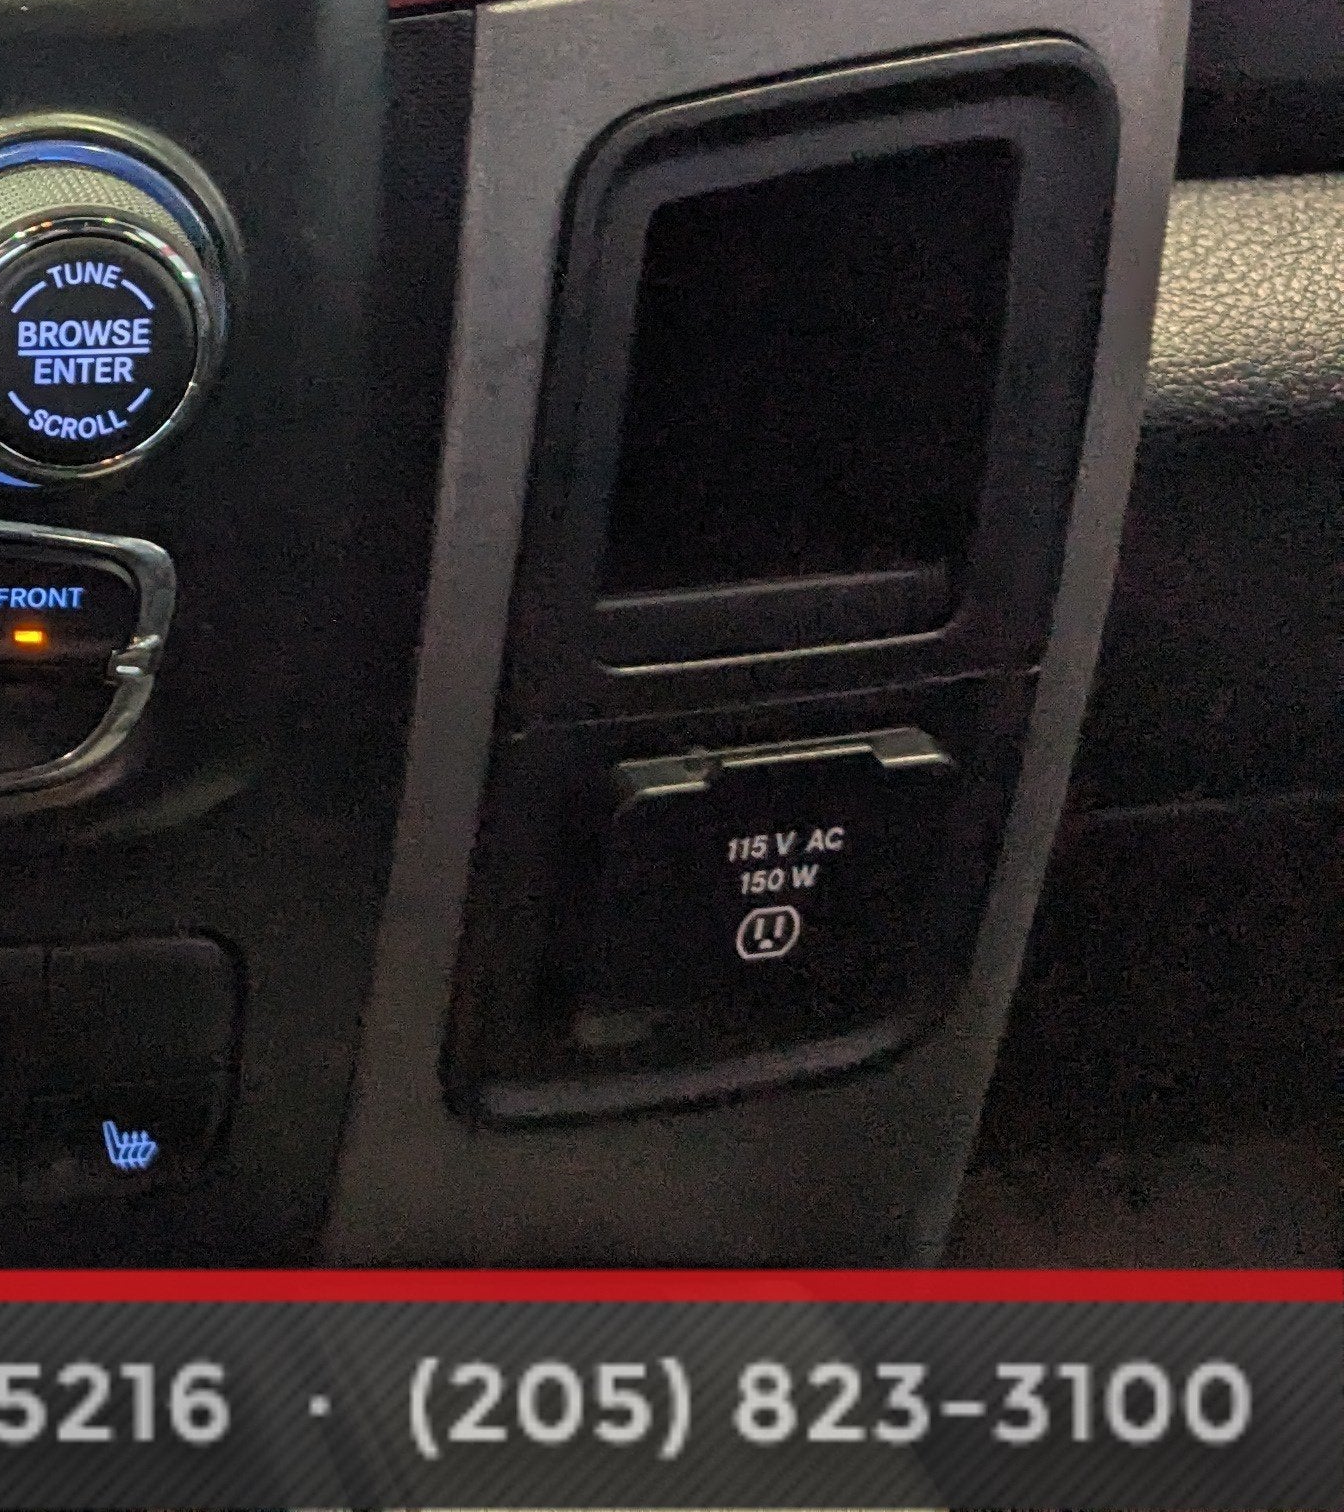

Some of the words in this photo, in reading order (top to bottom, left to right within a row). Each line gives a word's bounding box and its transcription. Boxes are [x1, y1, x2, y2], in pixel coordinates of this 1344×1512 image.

[47, 261, 121, 288] TUNE
[17, 319, 152, 348] BROWSE
[33, 357, 134, 385] ENTER
[28, 410, 127, 441] SCROLL
[728, 835, 766, 862] 115
[775, 832, 797, 855] V
[805, 827, 845, 853] AC
[741, 869, 782, 894] 150
[792, 864, 820, 889] W
